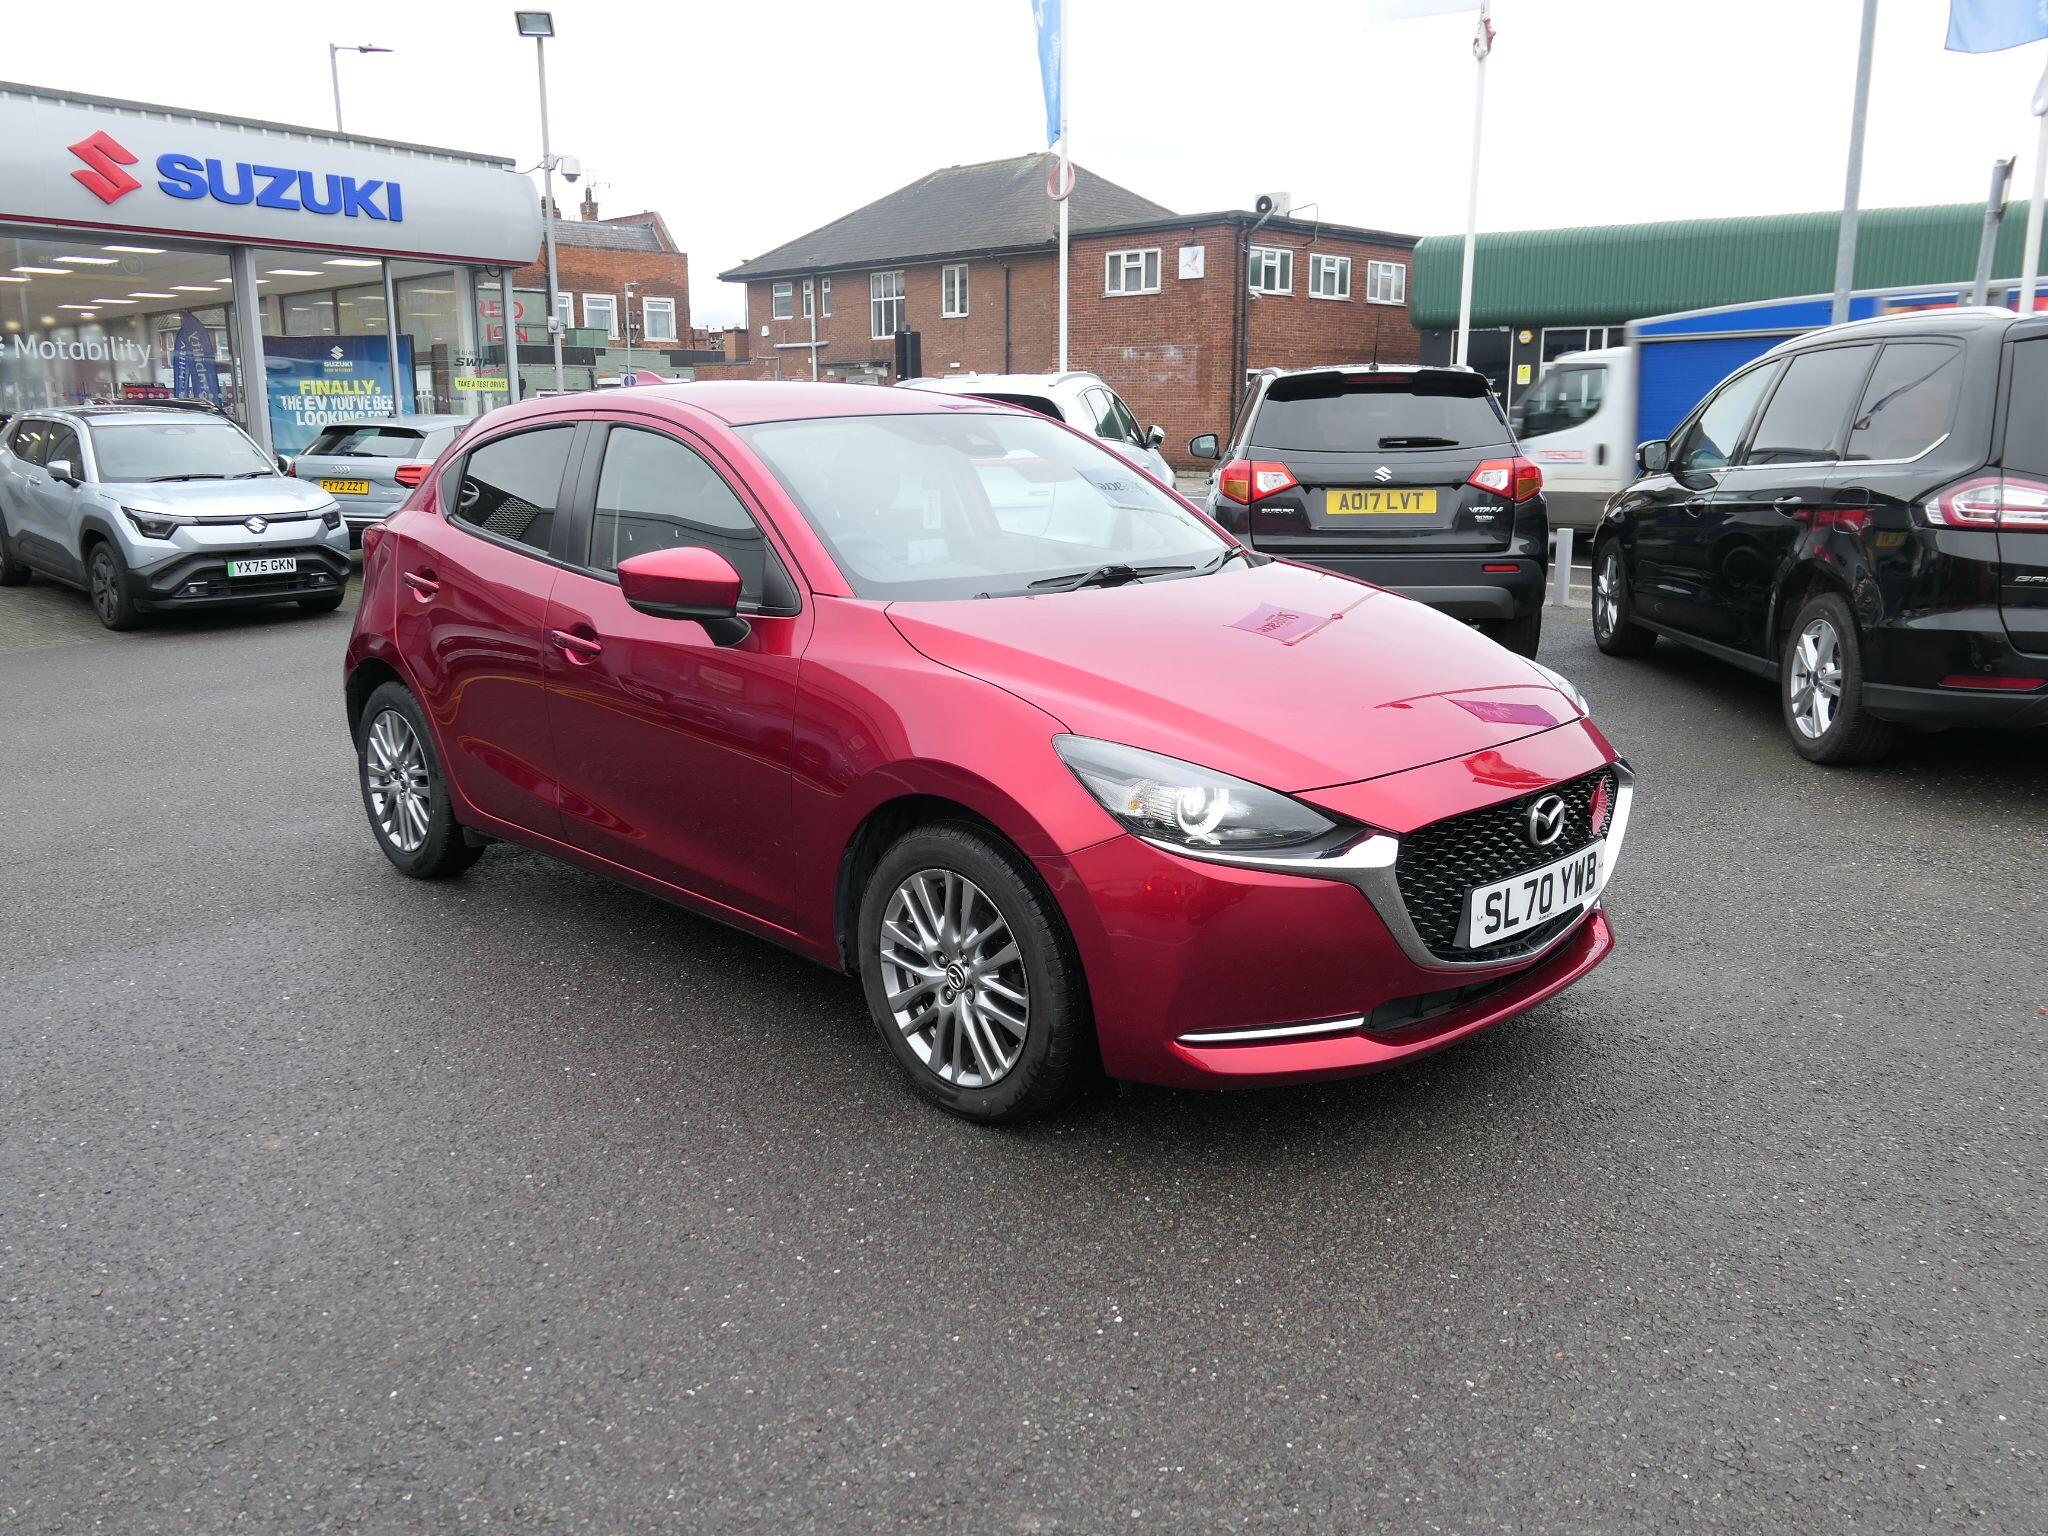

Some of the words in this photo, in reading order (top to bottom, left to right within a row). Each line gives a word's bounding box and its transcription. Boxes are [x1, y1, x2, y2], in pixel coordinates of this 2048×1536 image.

[156, 153, 403, 222] SUZUKI
[13, 334, 152, 368] Motability
[300, 380, 381, 395] FINALLY,
[458, 380, 471, 388] TAKE
[476, 380, 489, 388] TEST
[490, 380, 505, 389] DRIVE
[280, 395, 303, 411] THE
[304, 396, 328, 411] EV
[330, 396, 372, 411] YOU'VE
[347, 482, 365, 492] ZZT
[1387, 492, 1424, 510] LVT
[236, 560, 267, 573] YX75
[271, 558, 294, 571] GKN
[1484, 872, 1553, 935] SL70
[1561, 851, 1597, 905] YWB
